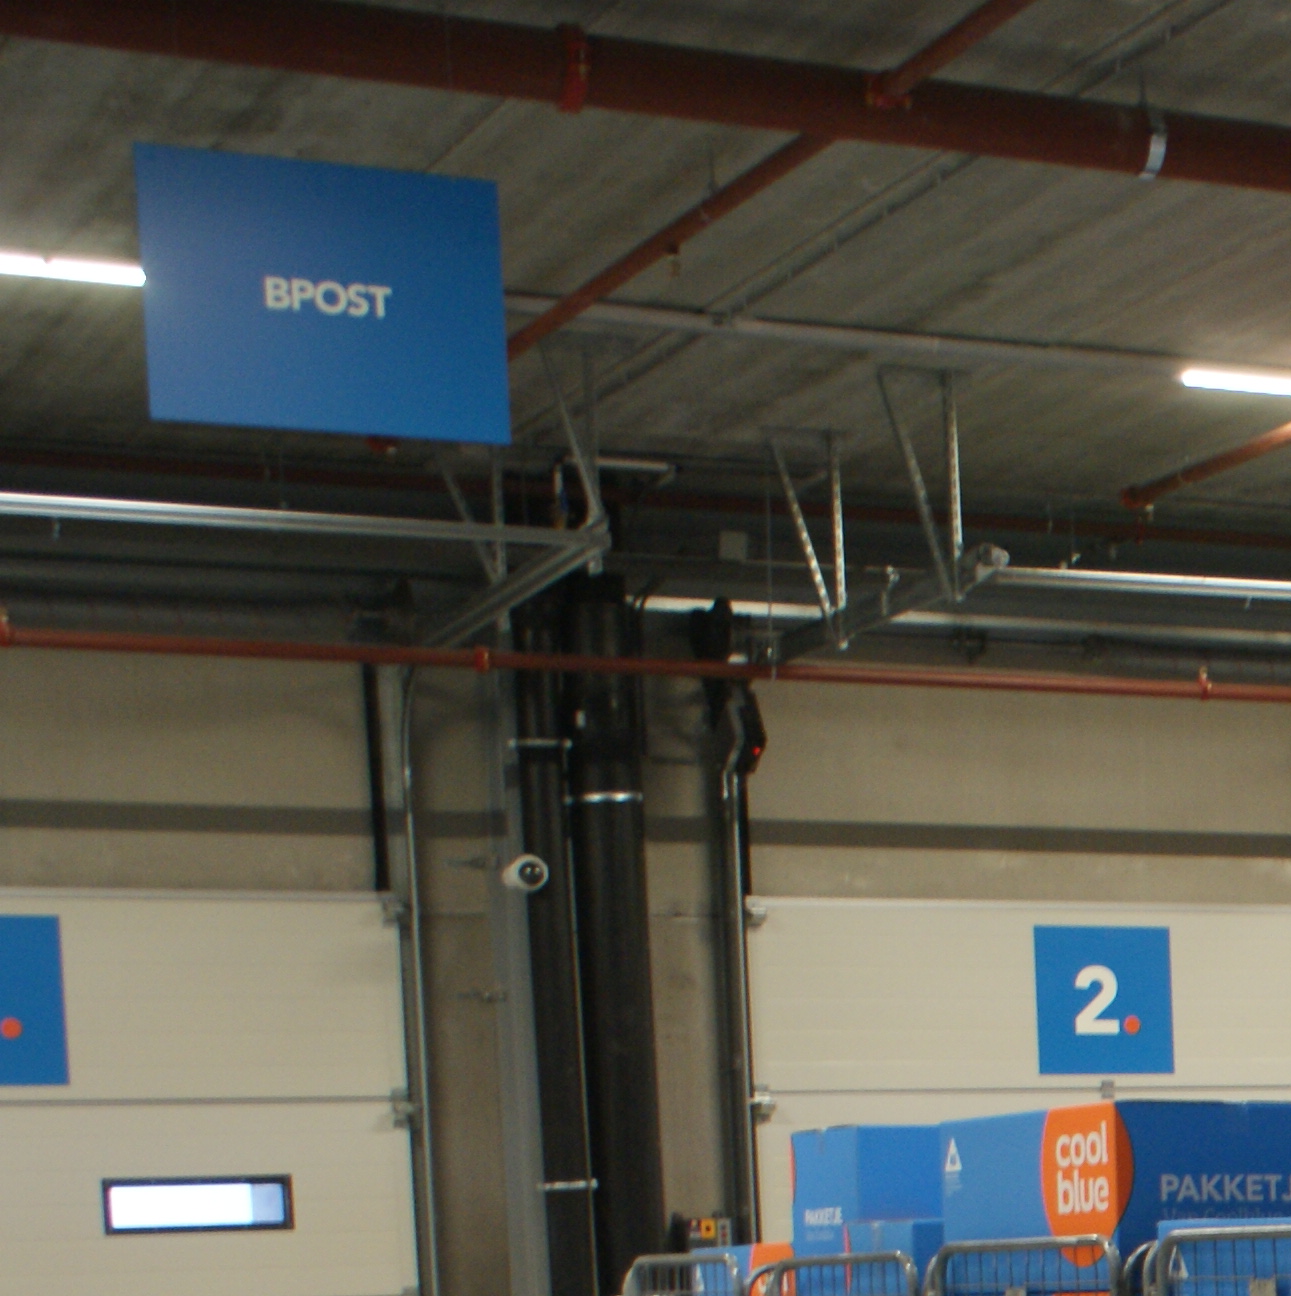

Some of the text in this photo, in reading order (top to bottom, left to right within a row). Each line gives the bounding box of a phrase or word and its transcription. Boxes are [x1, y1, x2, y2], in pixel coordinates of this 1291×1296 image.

[264, 275, 393, 320] BPOST
[1056, 1121, 1108, 1168] cool
[1056, 1171, 1109, 1215] blue
